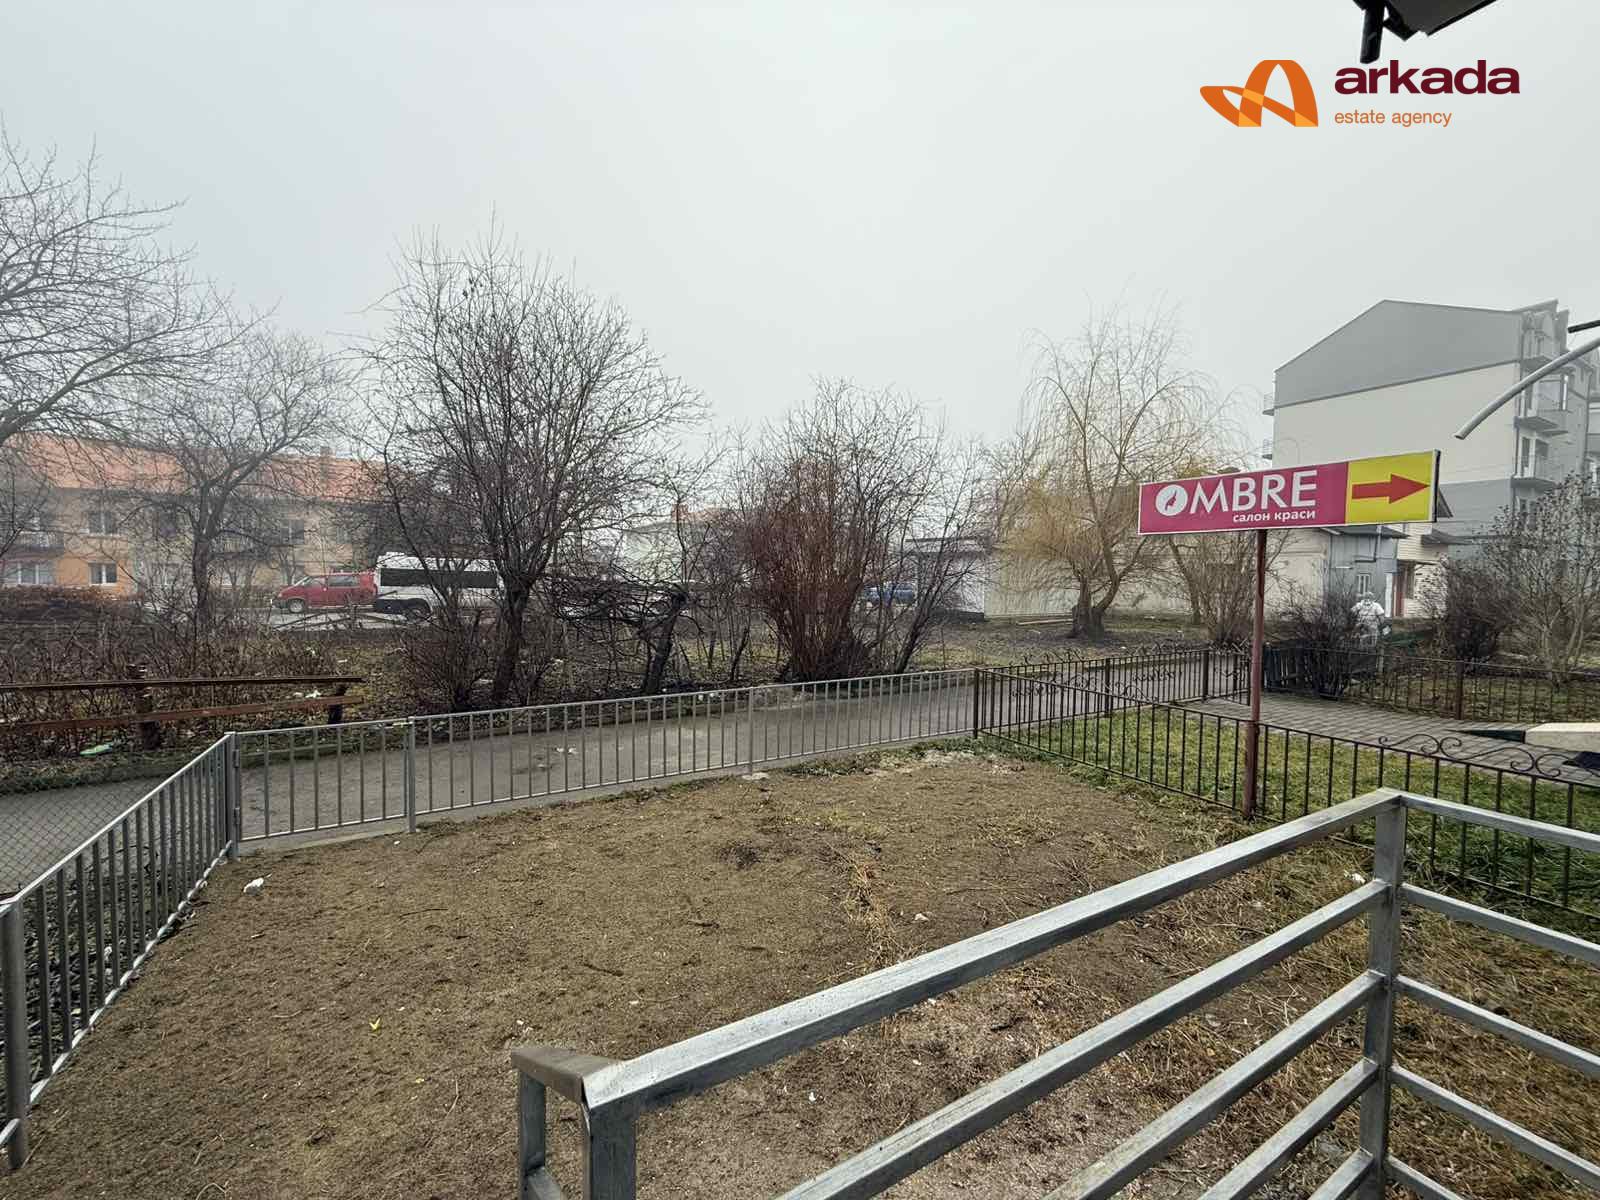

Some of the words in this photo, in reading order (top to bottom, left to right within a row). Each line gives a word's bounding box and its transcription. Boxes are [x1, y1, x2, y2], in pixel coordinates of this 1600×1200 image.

[1155, 469, 1318, 516] OMBRE
[1232, 511, 1271, 523] салон
[1274, 509, 1316, 523] краси
